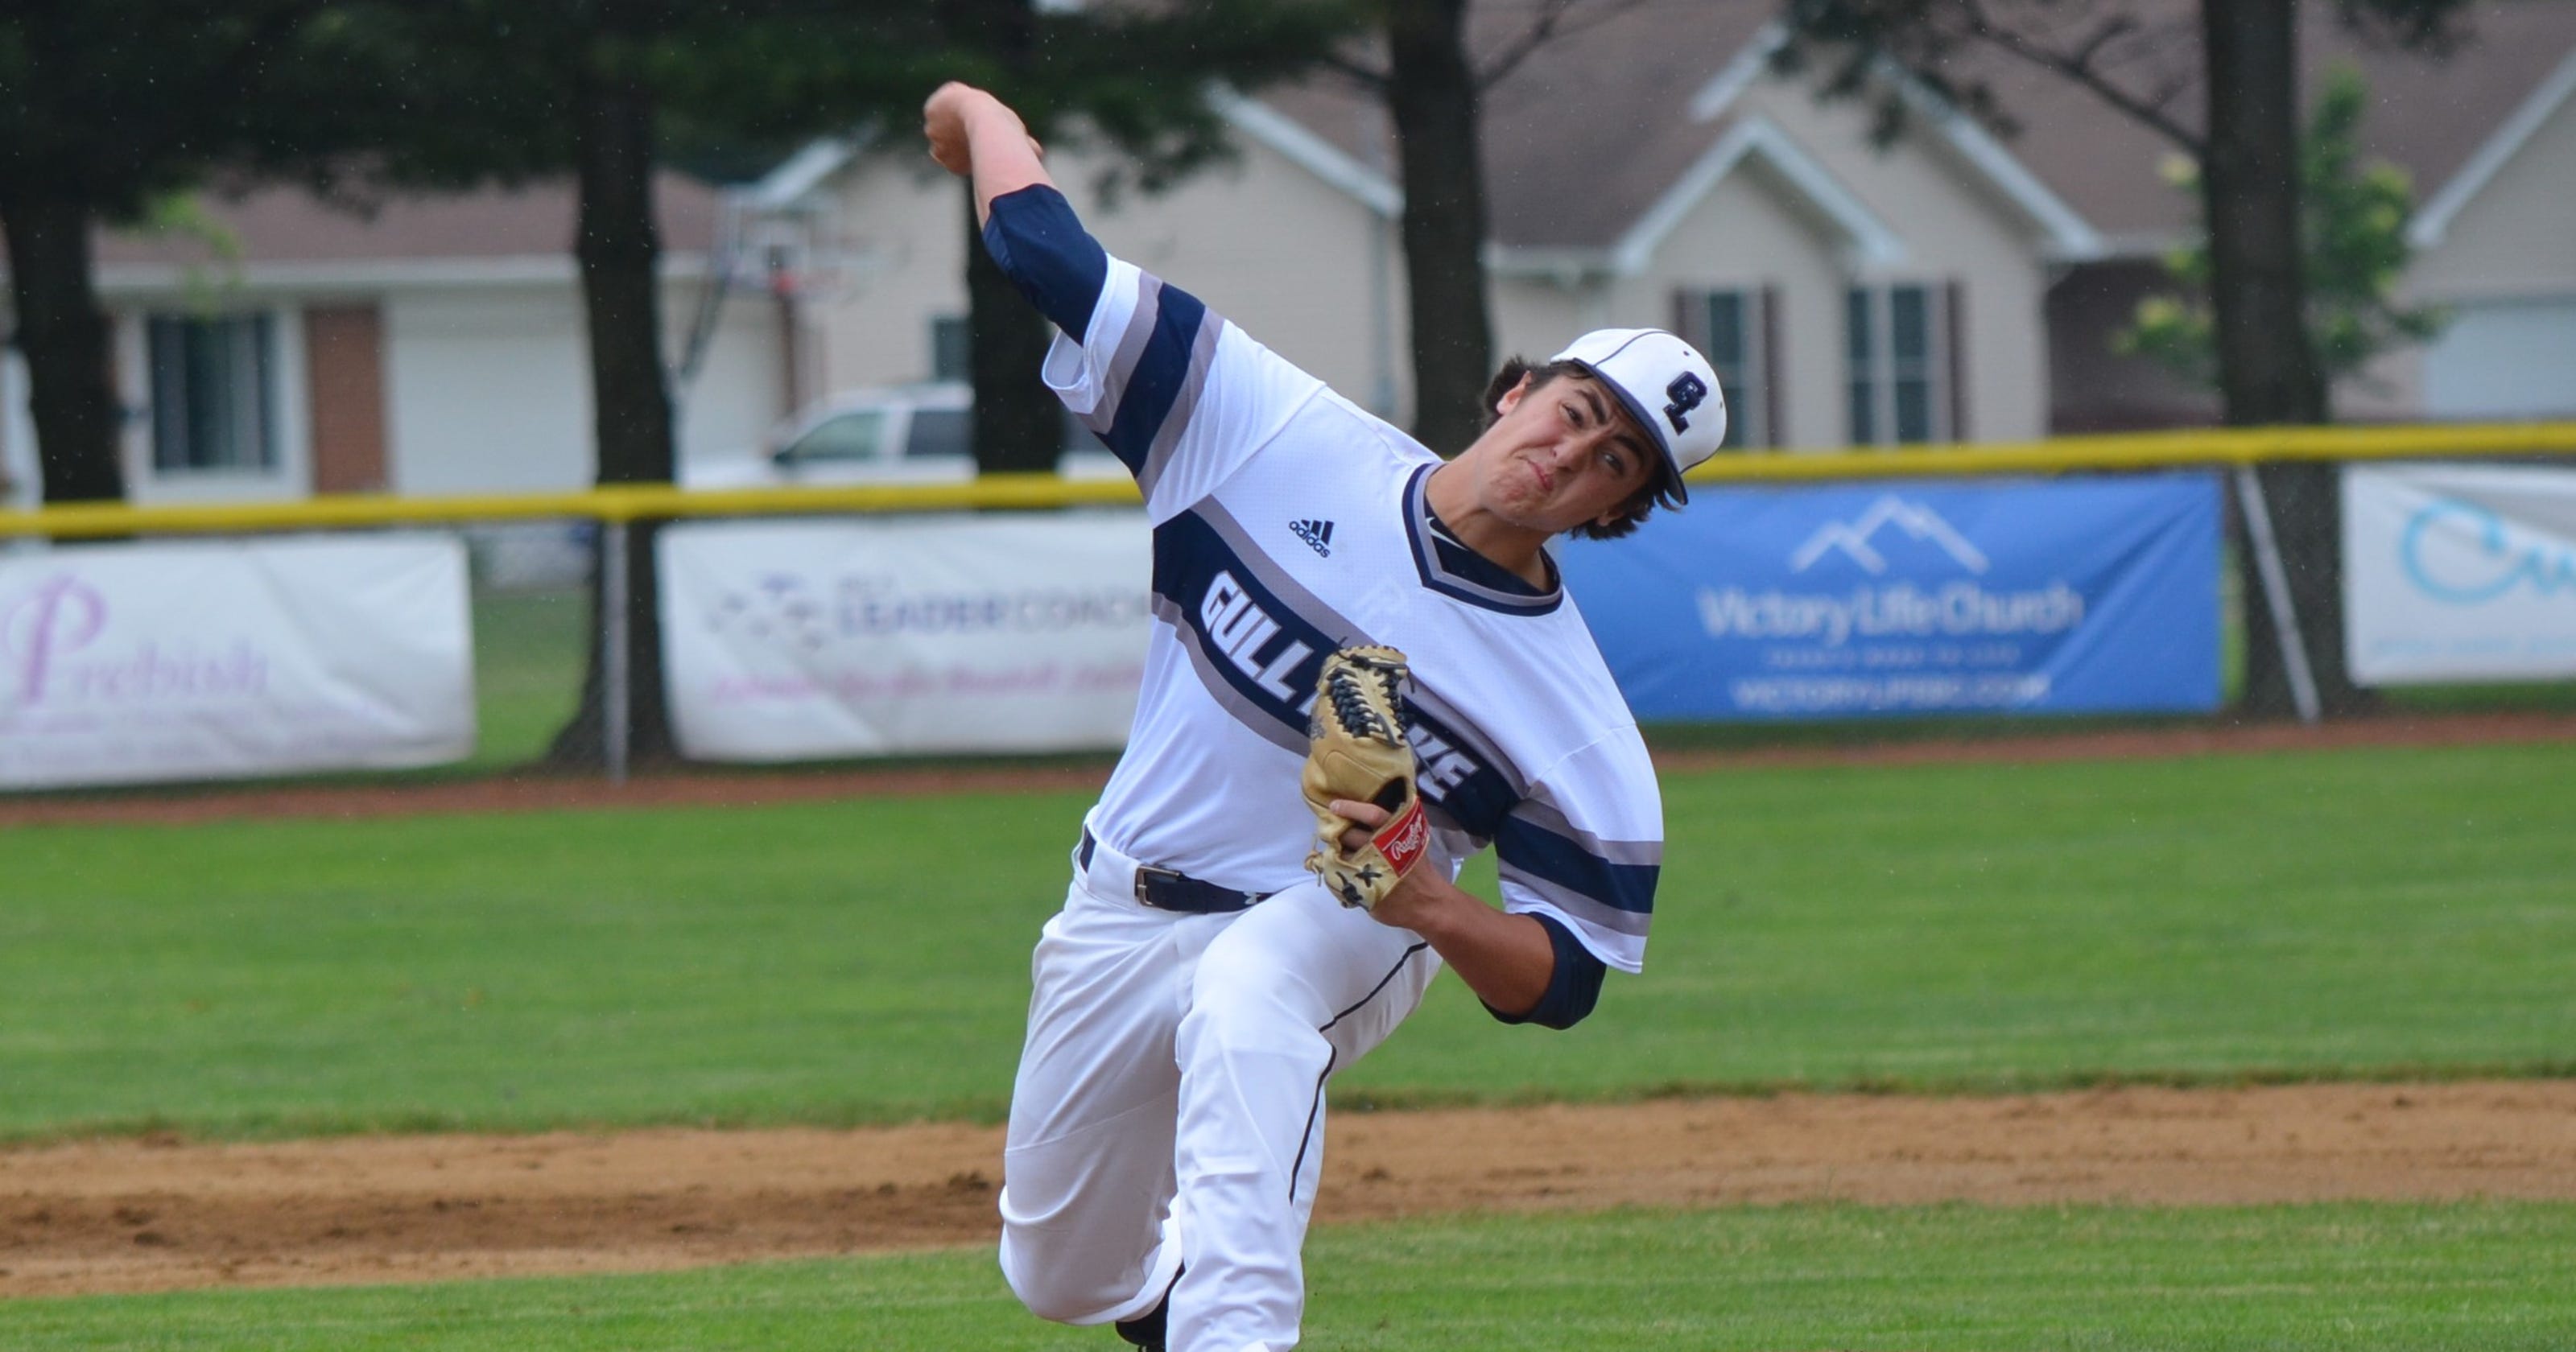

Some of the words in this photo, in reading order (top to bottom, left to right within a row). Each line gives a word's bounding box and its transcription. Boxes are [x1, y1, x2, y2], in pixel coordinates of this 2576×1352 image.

[1289, 521, 1331, 558] adidas
[1201, 570, 1314, 703] GULL
[1697, 585, 1850, 645] Victory
[1856, 581, 1938, 636] Life
[1942, 578, 2084, 633] Church
